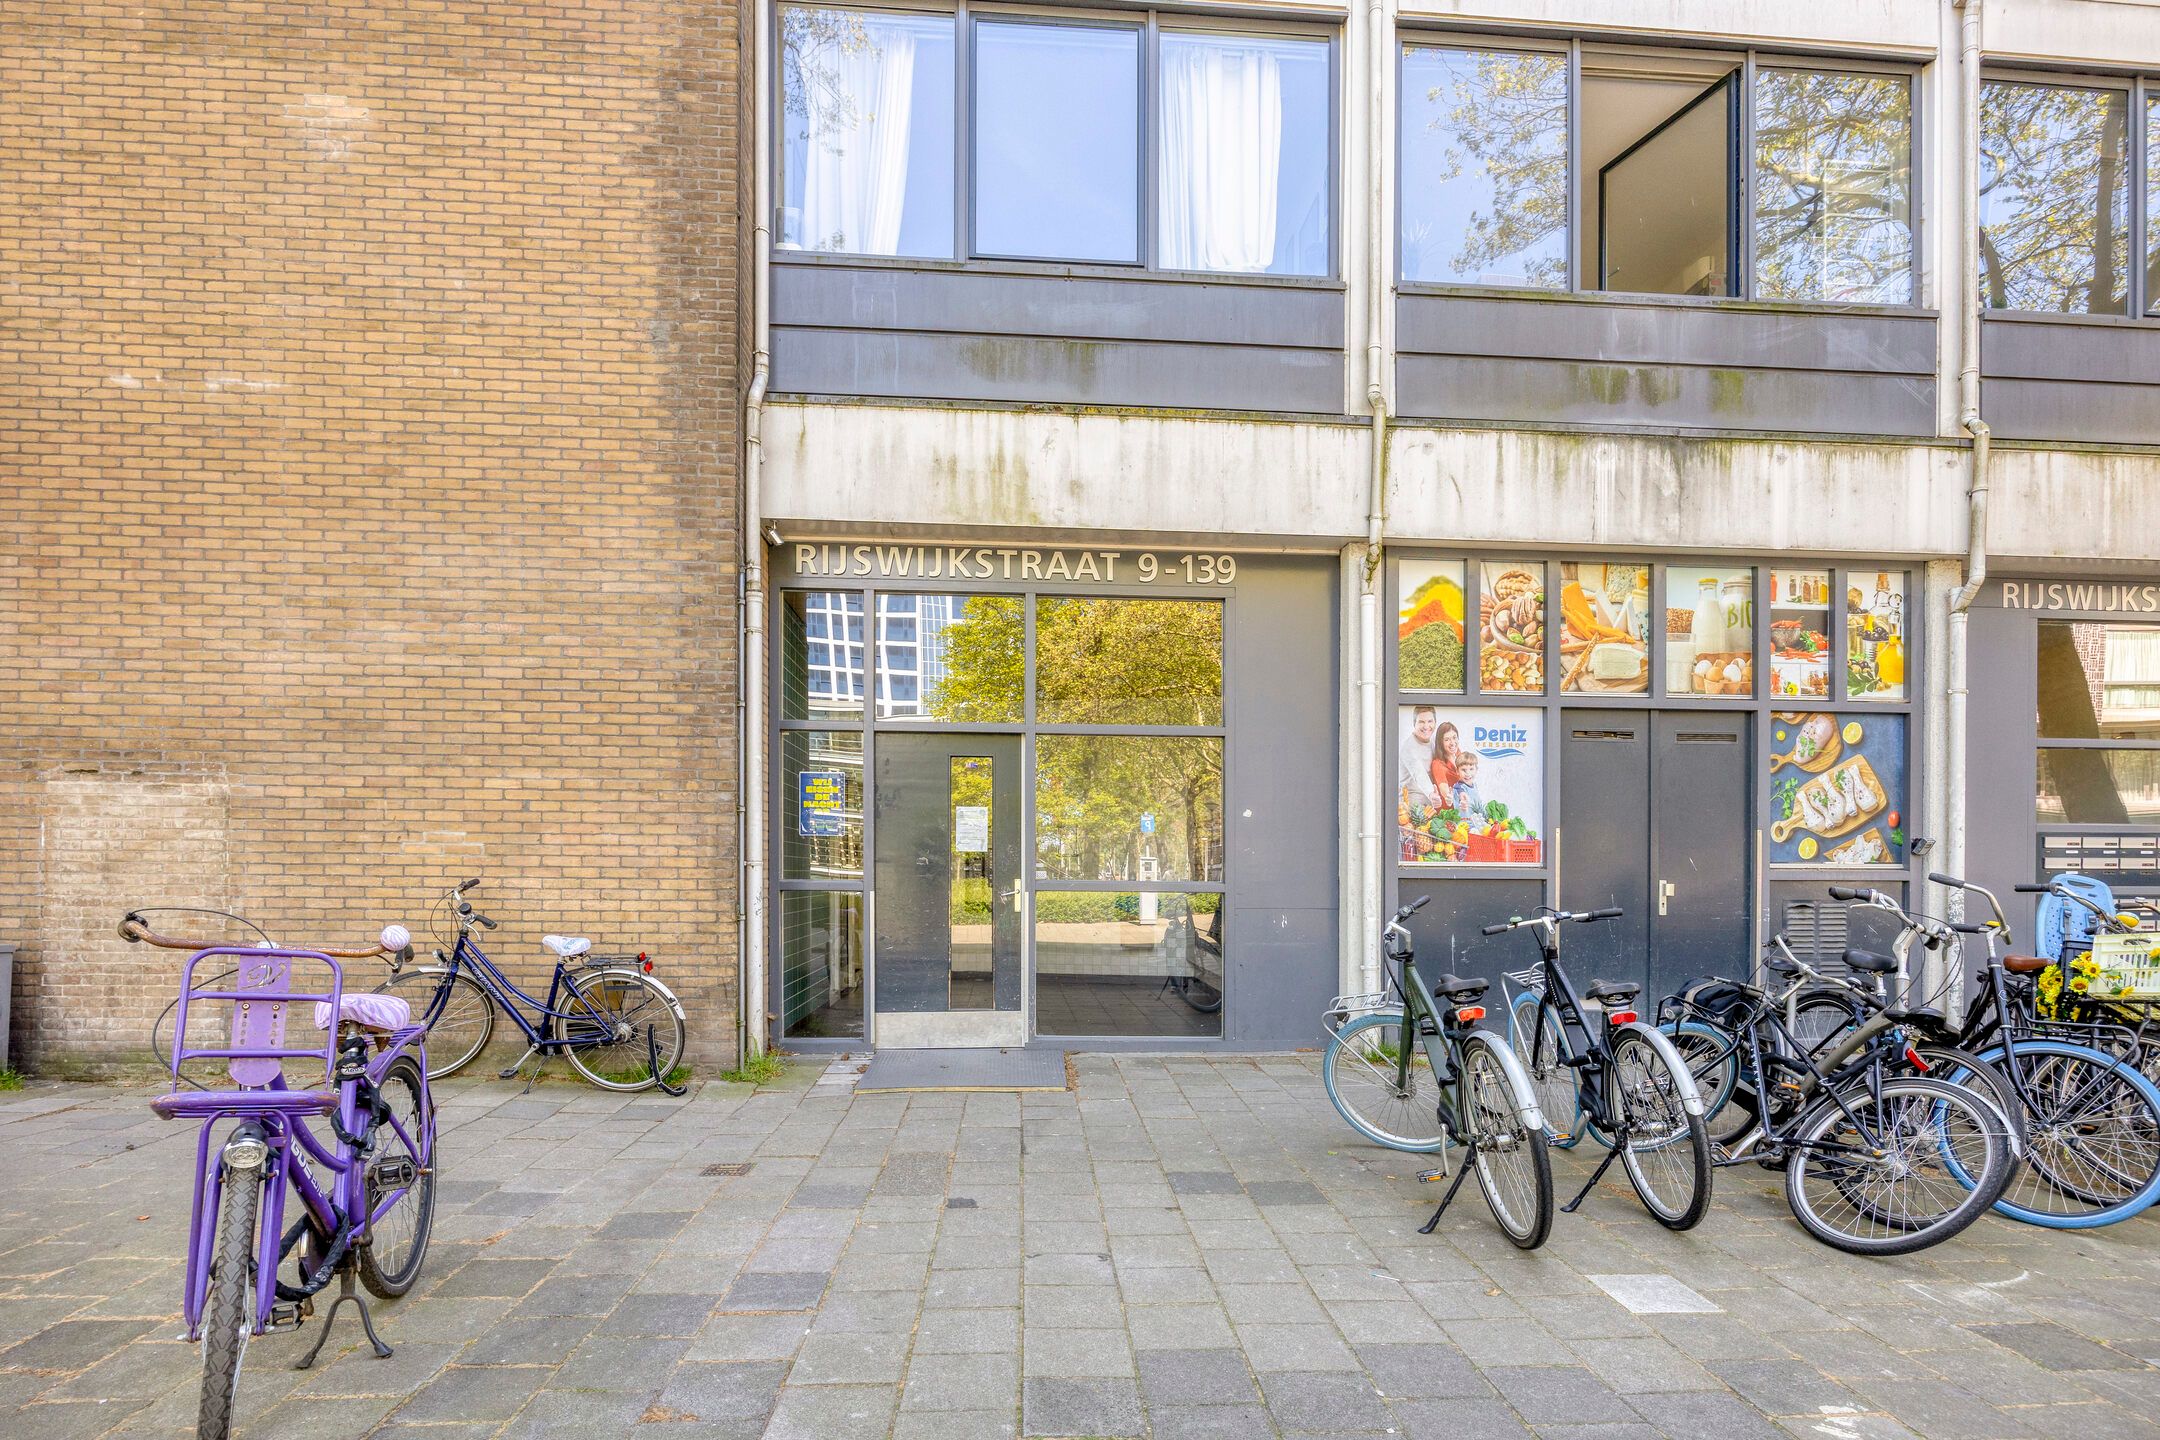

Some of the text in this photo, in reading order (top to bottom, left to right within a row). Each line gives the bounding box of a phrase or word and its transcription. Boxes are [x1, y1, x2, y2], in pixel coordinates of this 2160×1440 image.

[795, 543, 1237, 584] RIJSWIJKSTRAAT 9-139
[2002, 582, 2160, 612] RIJSWIJKS
[1474, 723, 1527, 742] Deniz
[471, 966, 505, 1001] GIANT
